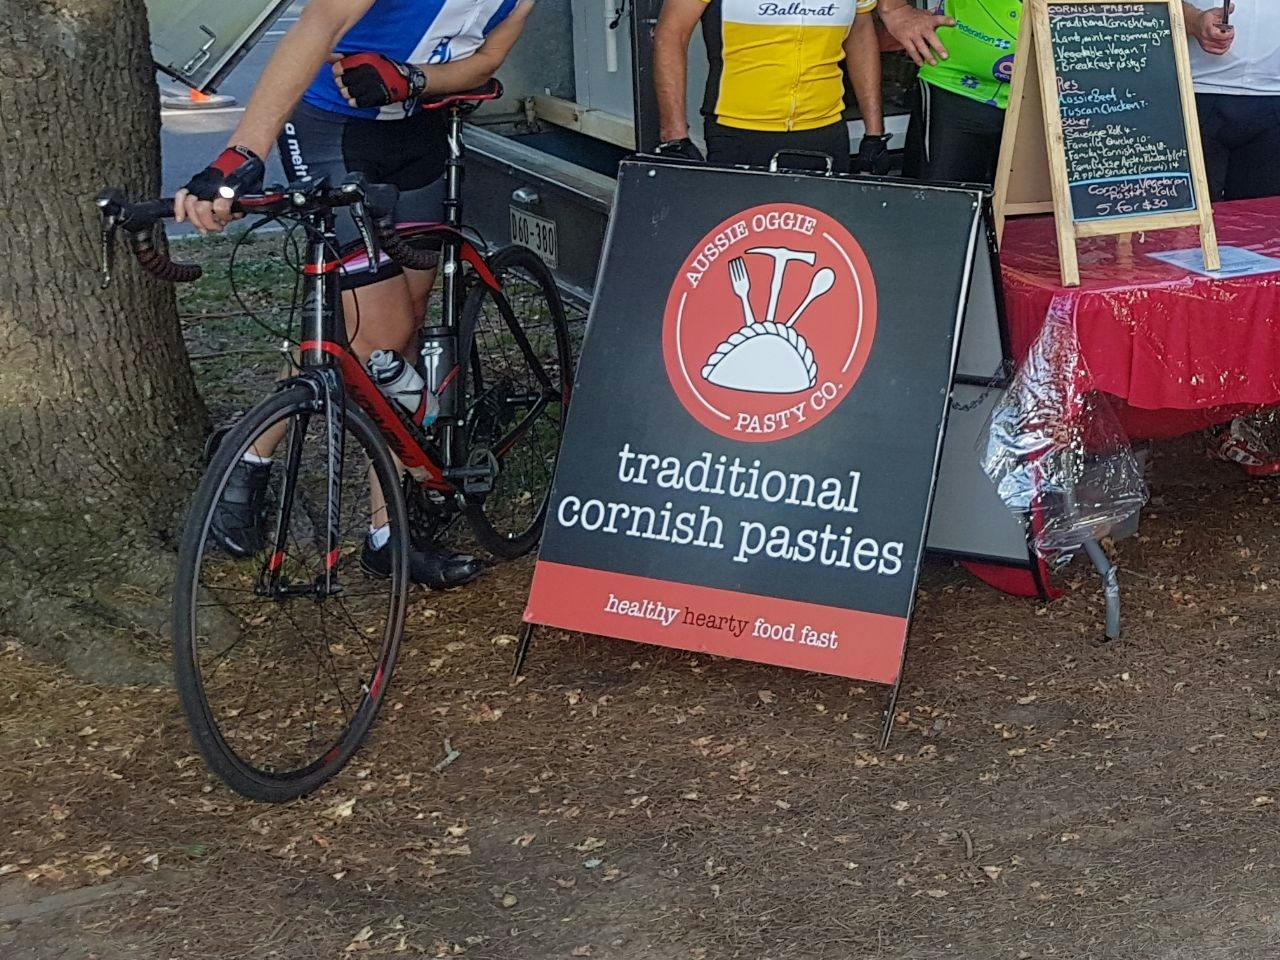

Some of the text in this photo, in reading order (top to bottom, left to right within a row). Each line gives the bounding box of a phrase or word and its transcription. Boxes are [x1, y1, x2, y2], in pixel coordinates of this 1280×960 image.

[757, 2, 841, 17] Ballarat
[1047, 3, 1146, 14] CORNISH PASTIES
[1056, 56, 1116, 72] Breakfast
[1060, 106, 1101, 117] Tuscan
[1100, 99, 1140, 115] Chicken
[1087, 180, 1134, 196] Cornish
[1095, 198, 1169, 216] 5 for $30
[511, 211, 555, 256] D60-380
[685, 211, 819, 289] AUSSIE OGGIE
[732, 381, 844, 435] PASTY CO.
[617, 442, 861, 514] traditional
[556, 494, 905, 577] cornish pasties
[603, 592, 840, 651] healthy hearty food fast
